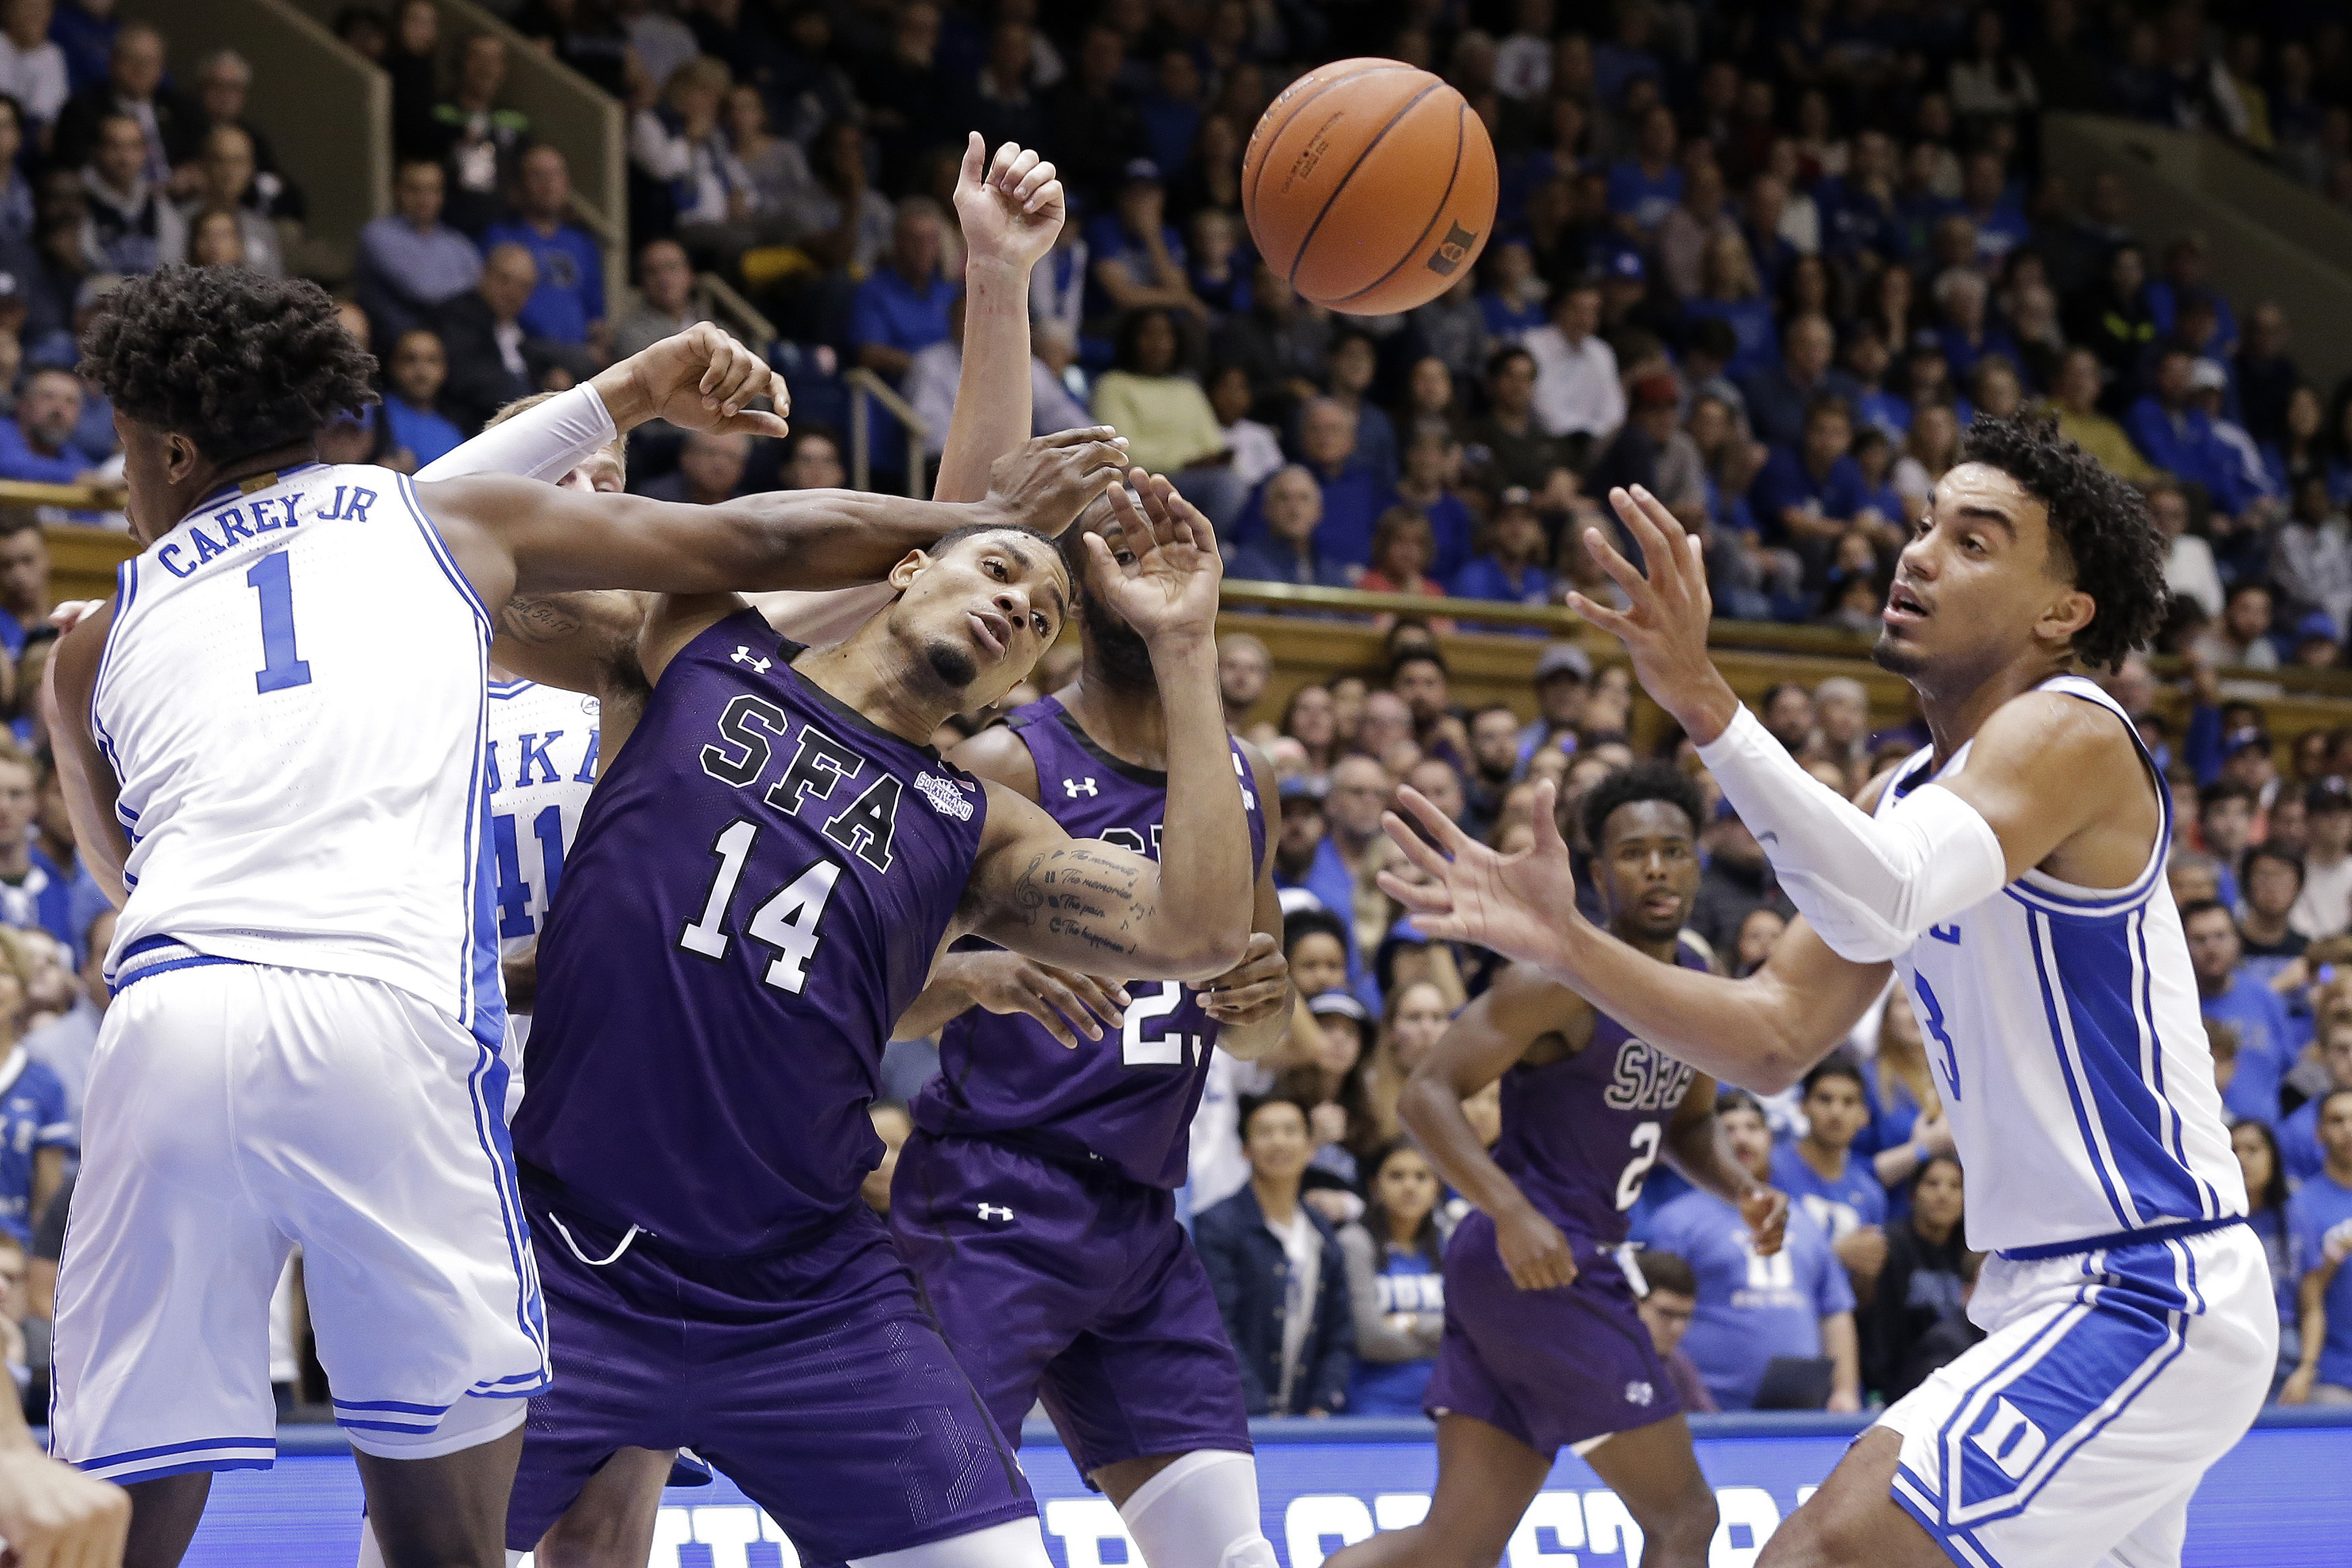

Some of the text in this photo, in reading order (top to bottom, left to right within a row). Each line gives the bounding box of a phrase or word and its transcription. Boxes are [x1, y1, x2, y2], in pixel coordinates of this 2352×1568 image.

[158, 485, 378, 578] CAREY JR
[246, 550, 312, 694] 1
[699, 693, 904, 874] SFA
[916, 772, 971, 820] SOUTHLAND
[677, 816, 844, 998] 14
[1122, 980, 1203, 1067] 2
[1616, 1120, 1662, 1211] 2
[1969, 1394, 2048, 1480] D
